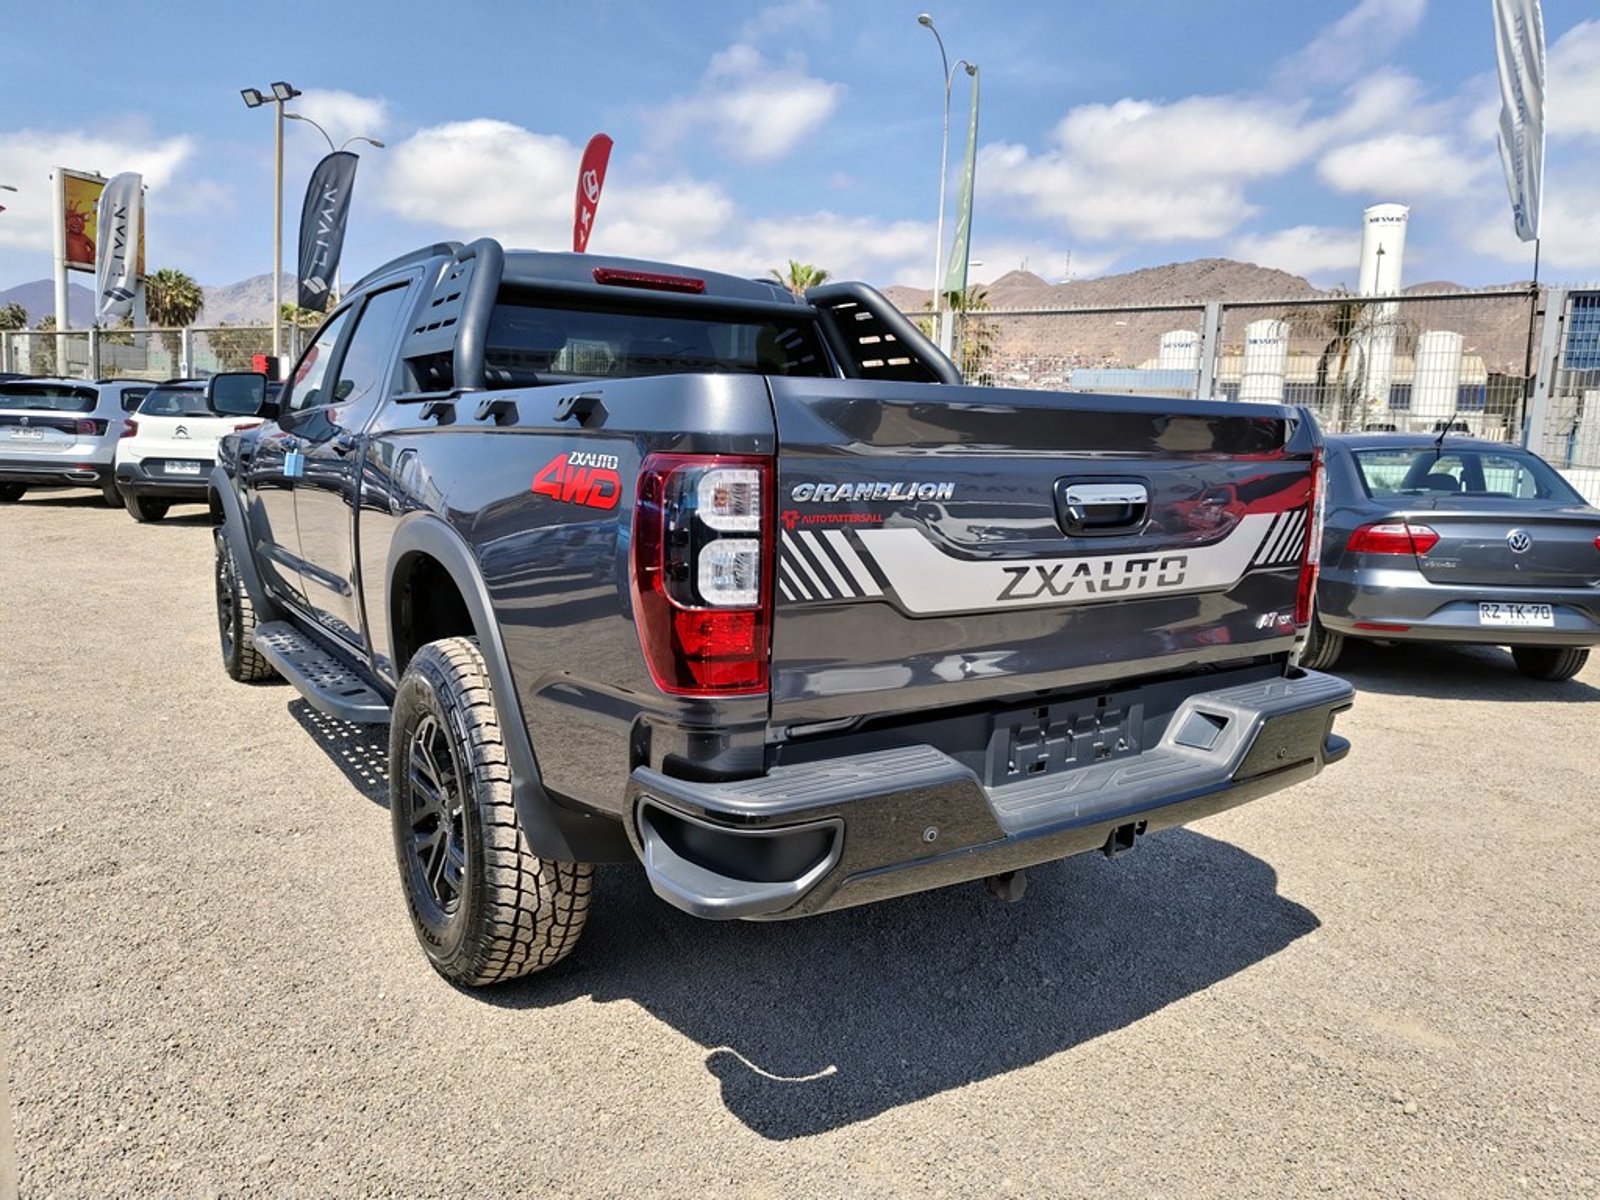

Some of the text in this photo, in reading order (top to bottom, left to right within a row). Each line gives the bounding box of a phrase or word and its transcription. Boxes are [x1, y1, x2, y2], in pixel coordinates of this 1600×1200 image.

[567, 451, 619, 470] ZXAUTO
[531, 451, 622, 510] 4WD
[791, 482, 956, 503] GRANDLION
[996, 555, 1189, 601] ZXAUTO
